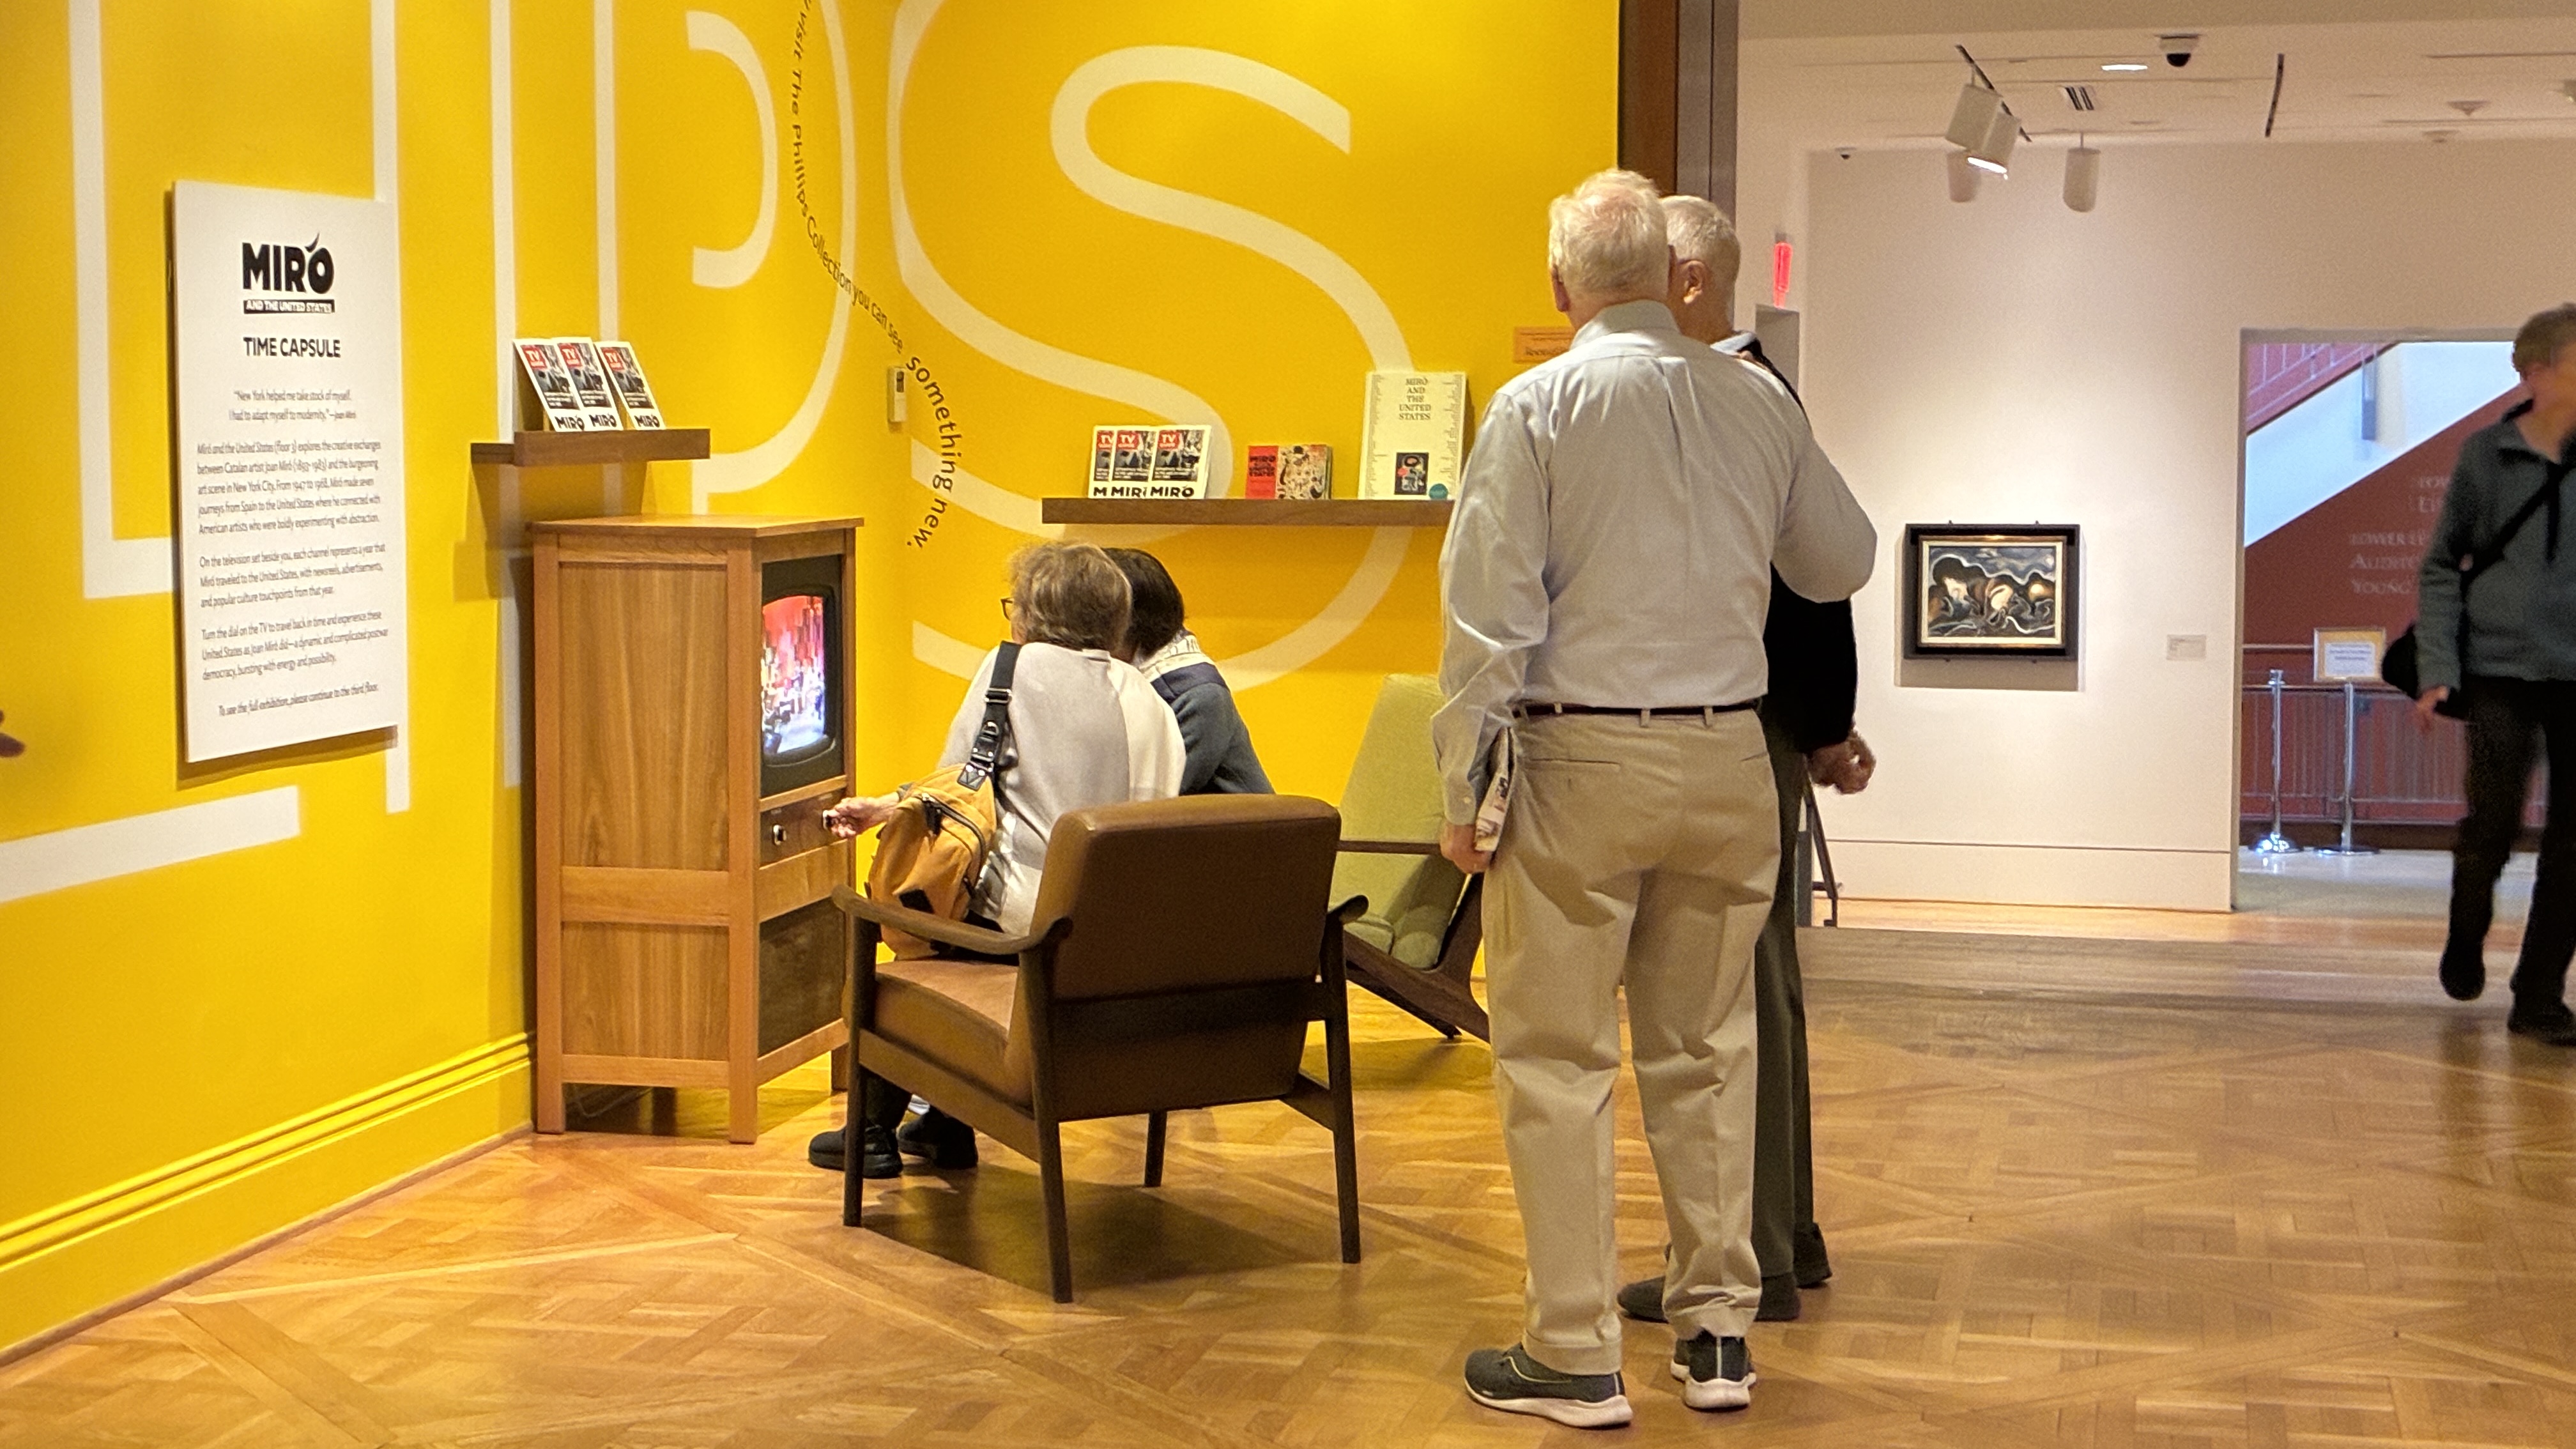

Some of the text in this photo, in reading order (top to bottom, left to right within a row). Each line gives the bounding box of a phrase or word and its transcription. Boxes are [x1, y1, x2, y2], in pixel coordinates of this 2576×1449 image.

[792, 70, 802, 115] The
[792, 124, 808, 217] Phillips
[242, 233, 335, 295] MIRÓ
[807, 215, 852, 295] Collection
[246, 300, 332, 313] AND THE UNITED STATES
[851, 284, 871, 312] you
[871, 302, 887, 330] can
[243, 337, 341, 358] TIME CAPSULE
[905, 356, 962, 493] something
[1119, 434, 1136, 444] TV
[1162, 434, 1176, 443] TV
[906, 496, 948, 549] new.
